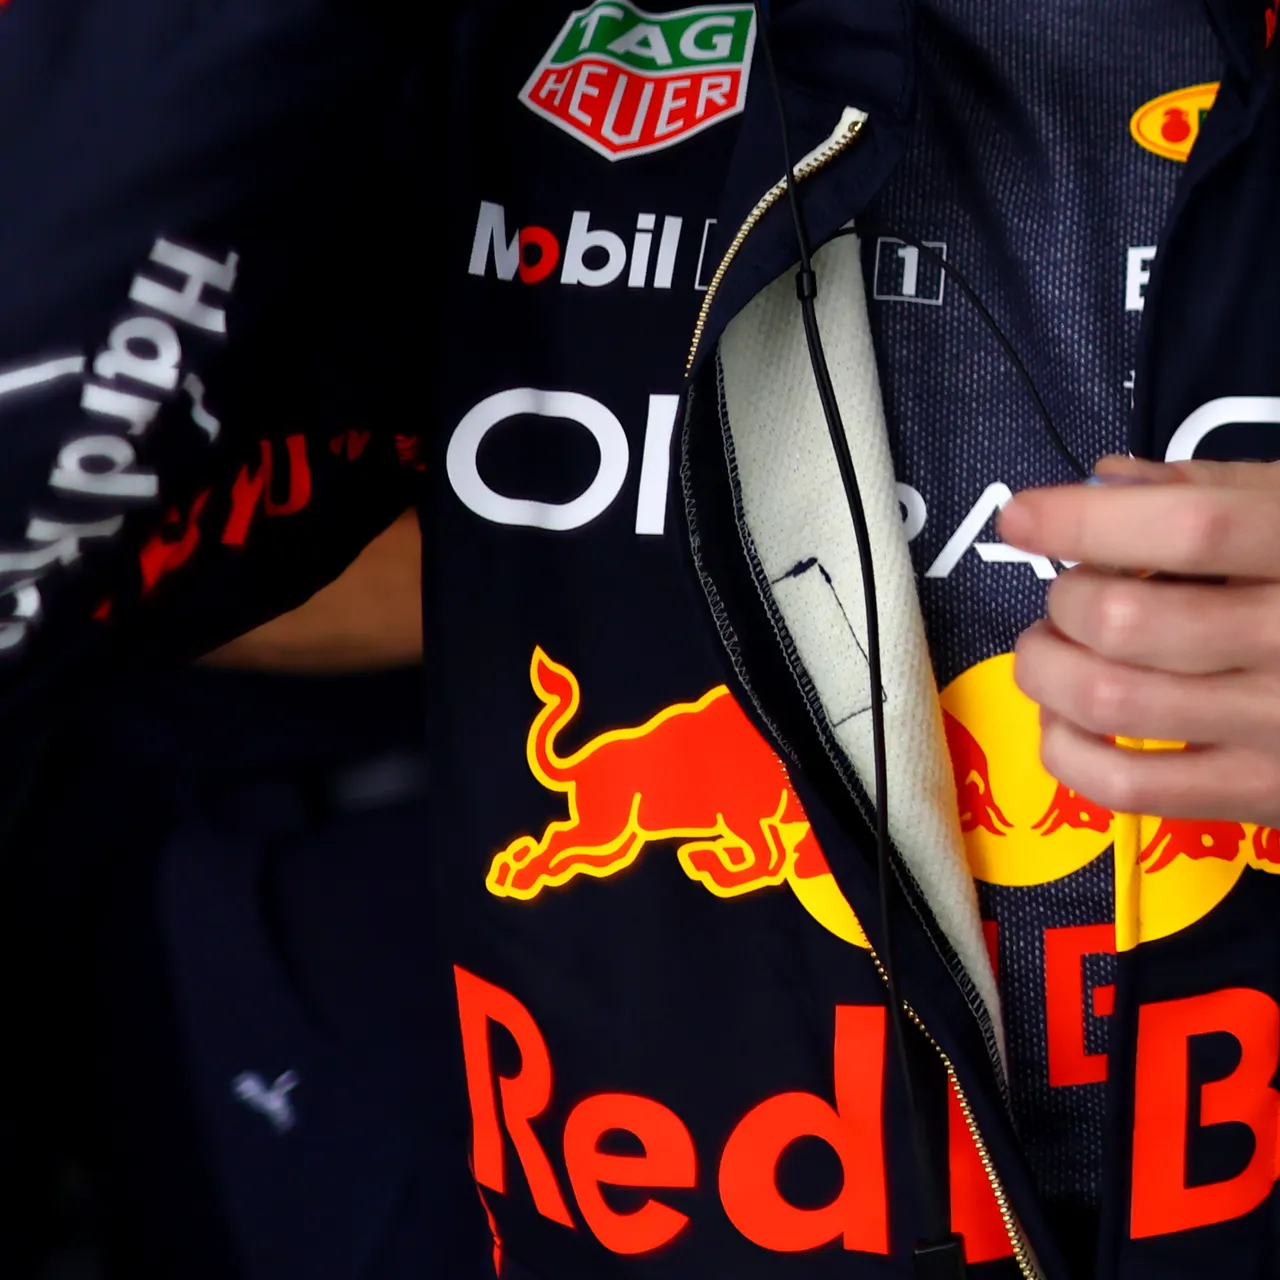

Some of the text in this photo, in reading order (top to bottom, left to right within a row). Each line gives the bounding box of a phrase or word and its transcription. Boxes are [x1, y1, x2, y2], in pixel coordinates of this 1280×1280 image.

[572, 6, 737, 66] TAG
[536, 64, 733, 145] HEUER
[467, 200, 683, 290] Mobil
[896, 245, 920, 297] 1
[48, 236, 240, 498] Hard
[453, 963, 890, 1255] Red
